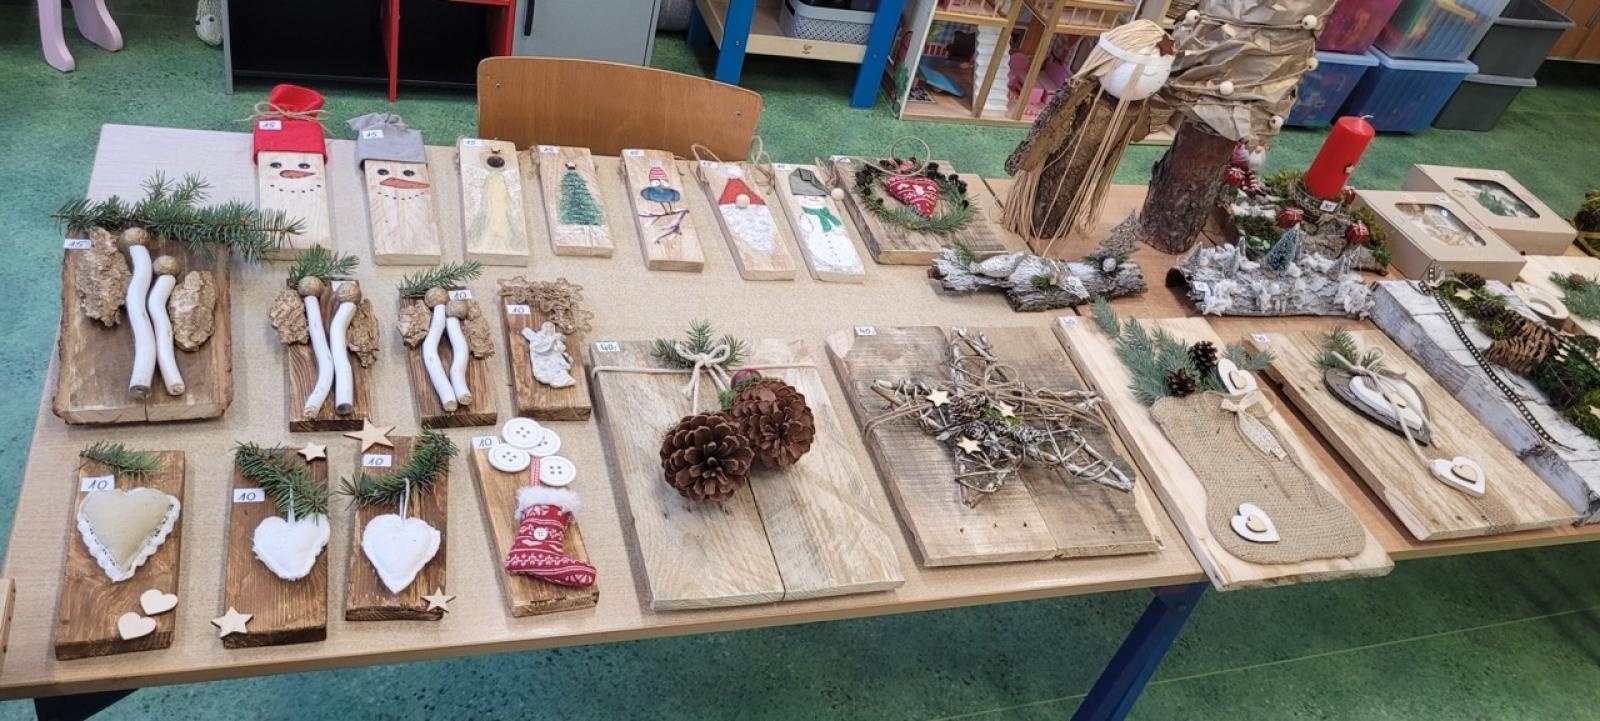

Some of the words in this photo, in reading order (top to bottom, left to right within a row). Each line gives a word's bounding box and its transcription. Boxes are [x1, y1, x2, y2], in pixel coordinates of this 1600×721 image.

[70, 240, 89, 248] 15
[478, 437, 493, 447] 10
[367, 457, 384, 466] 10
[88, 479, 108, 490] 10
[238, 491, 257, 501] 10
